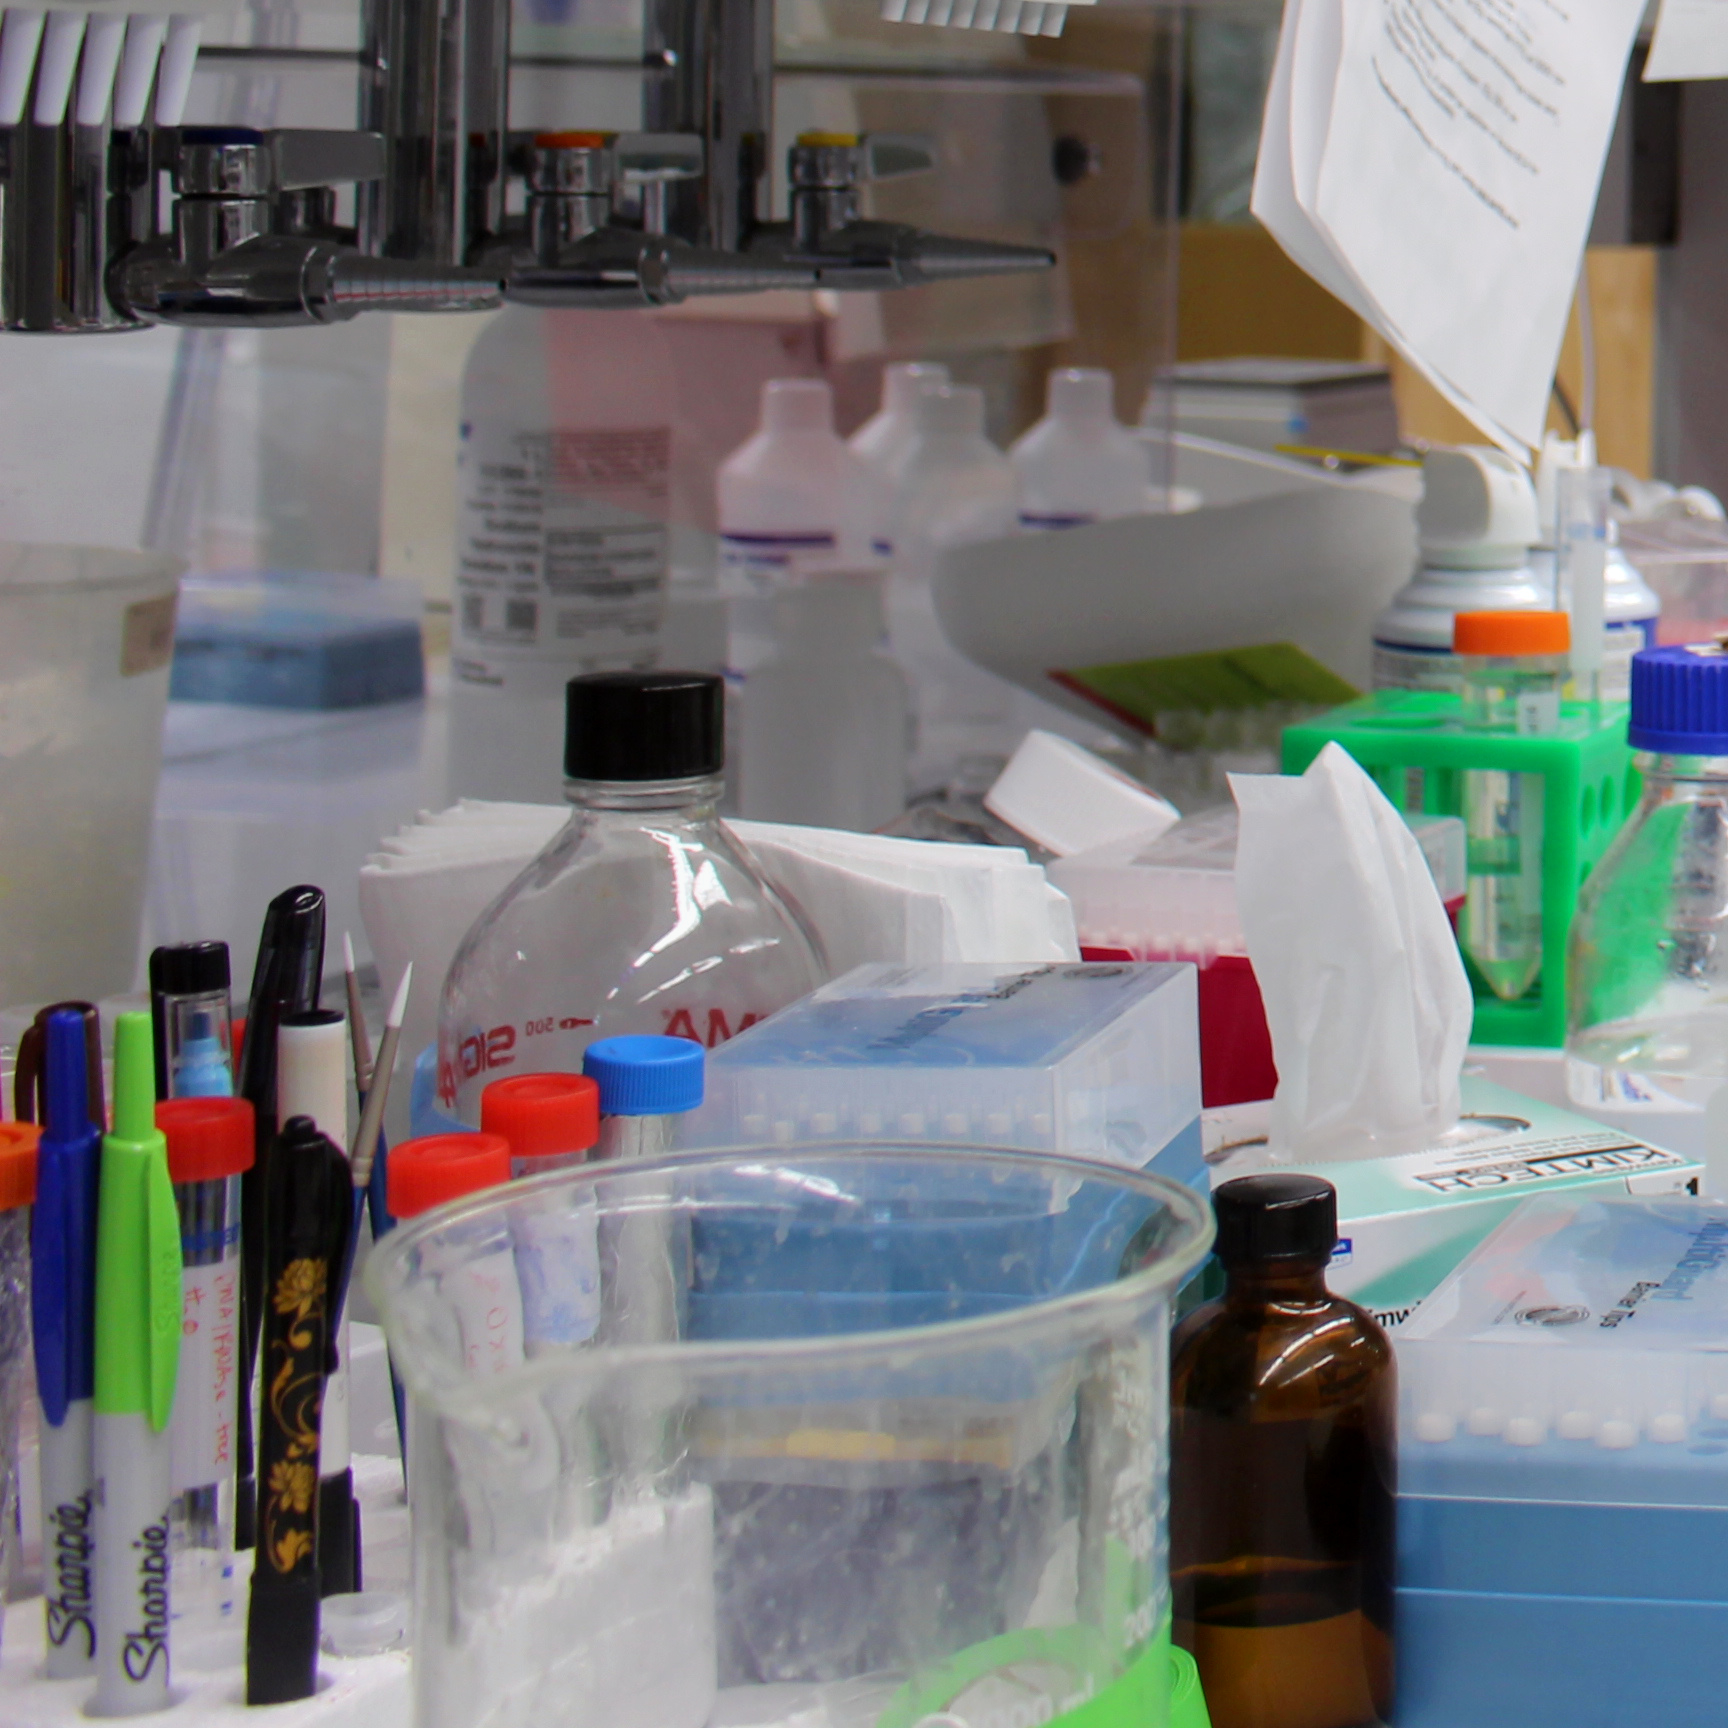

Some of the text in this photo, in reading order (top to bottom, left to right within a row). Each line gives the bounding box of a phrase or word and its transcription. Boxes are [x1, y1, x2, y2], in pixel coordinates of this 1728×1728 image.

[1398, 1144, 1669, 1193] KIMTECH
[48, 1487, 96, 1659] Sharpie
[124, 1515, 170, 1687] Sharpie
